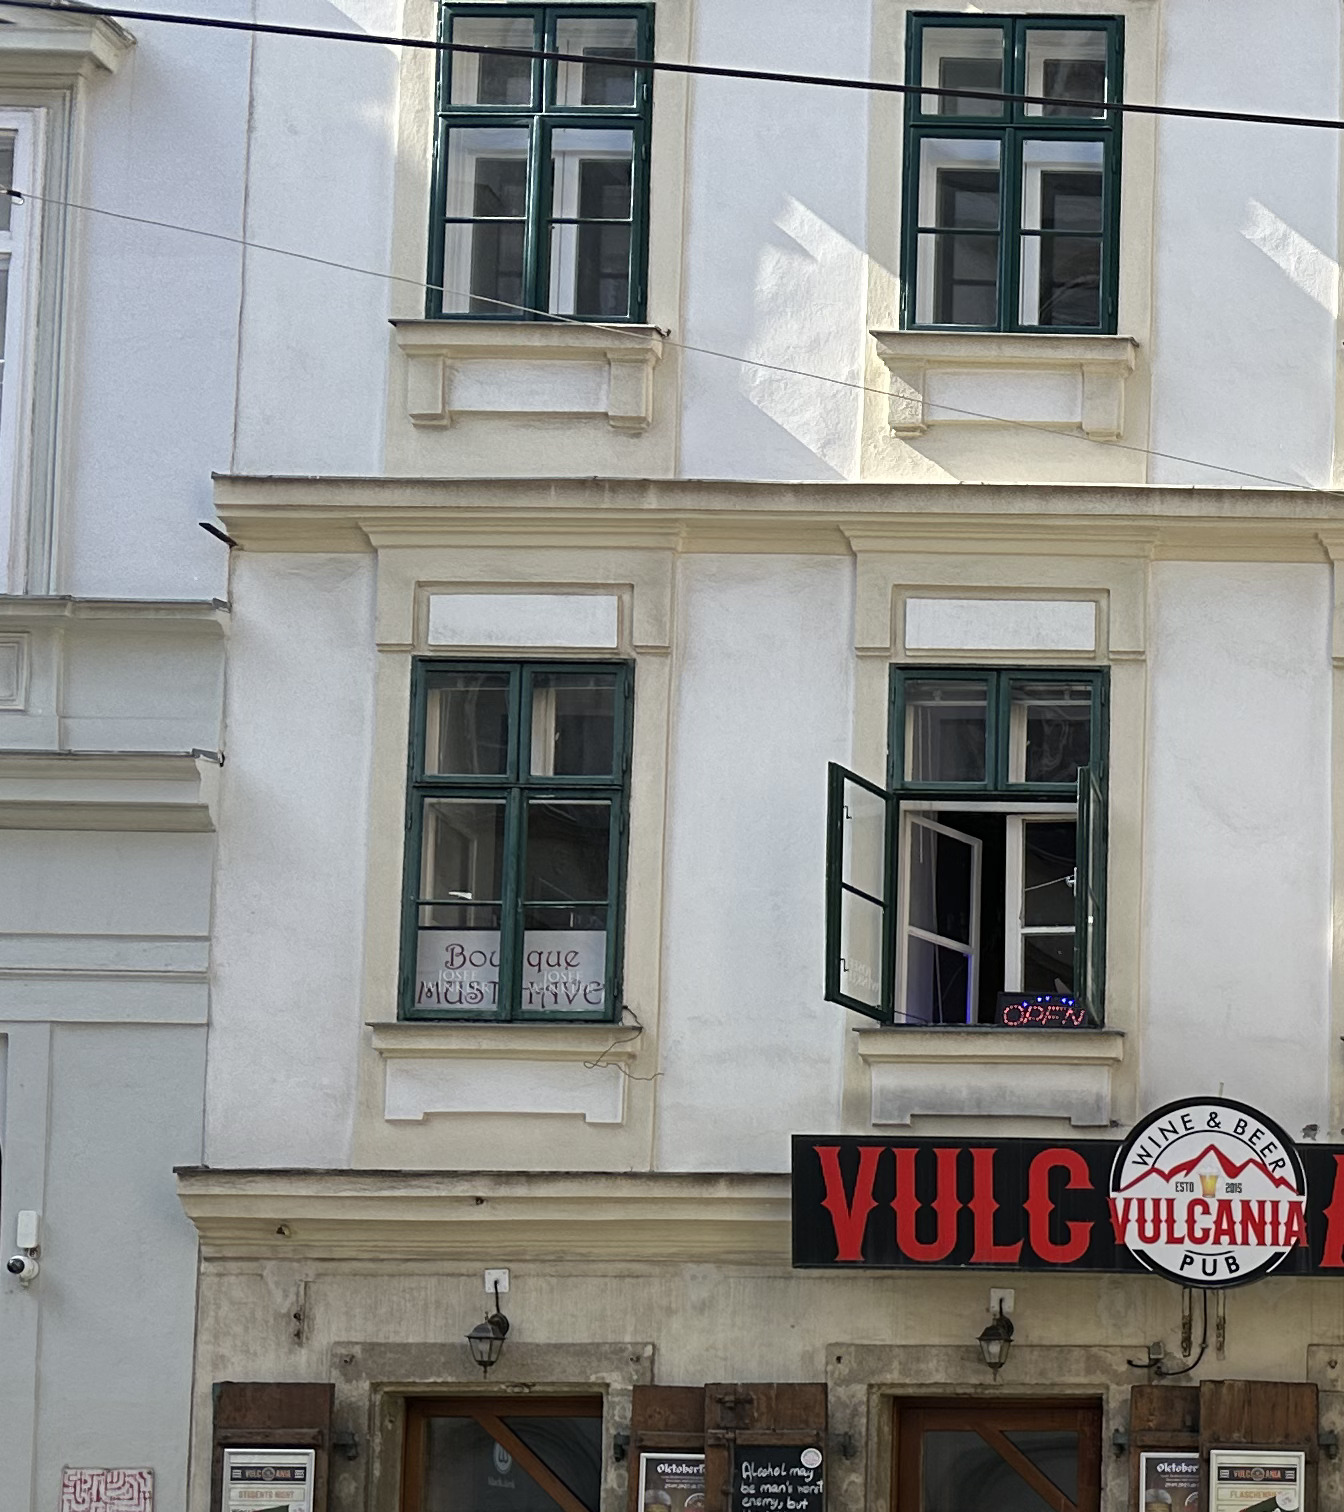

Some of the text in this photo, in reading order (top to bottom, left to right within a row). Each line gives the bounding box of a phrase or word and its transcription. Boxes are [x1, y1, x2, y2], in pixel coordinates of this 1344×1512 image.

[445, 943, 581, 973] Bouque
[1003, 1005, 1086, 1026] OPEN
[1131, 1111, 1287, 1174] WINE & BEER
[813, 1145, 1095, 1263] VULC
[1105, 1196, 1310, 1248] VULCANIA
[1179, 1253, 1240, 1277] PUB
[656, 1463, 706, 1474] Oktoberf
[789, 1467, 815, 1483] may
[740, 1480, 756, 1494] be
[760, 1480, 793, 1494] man's
[786, 1496, 809, 1510] but
